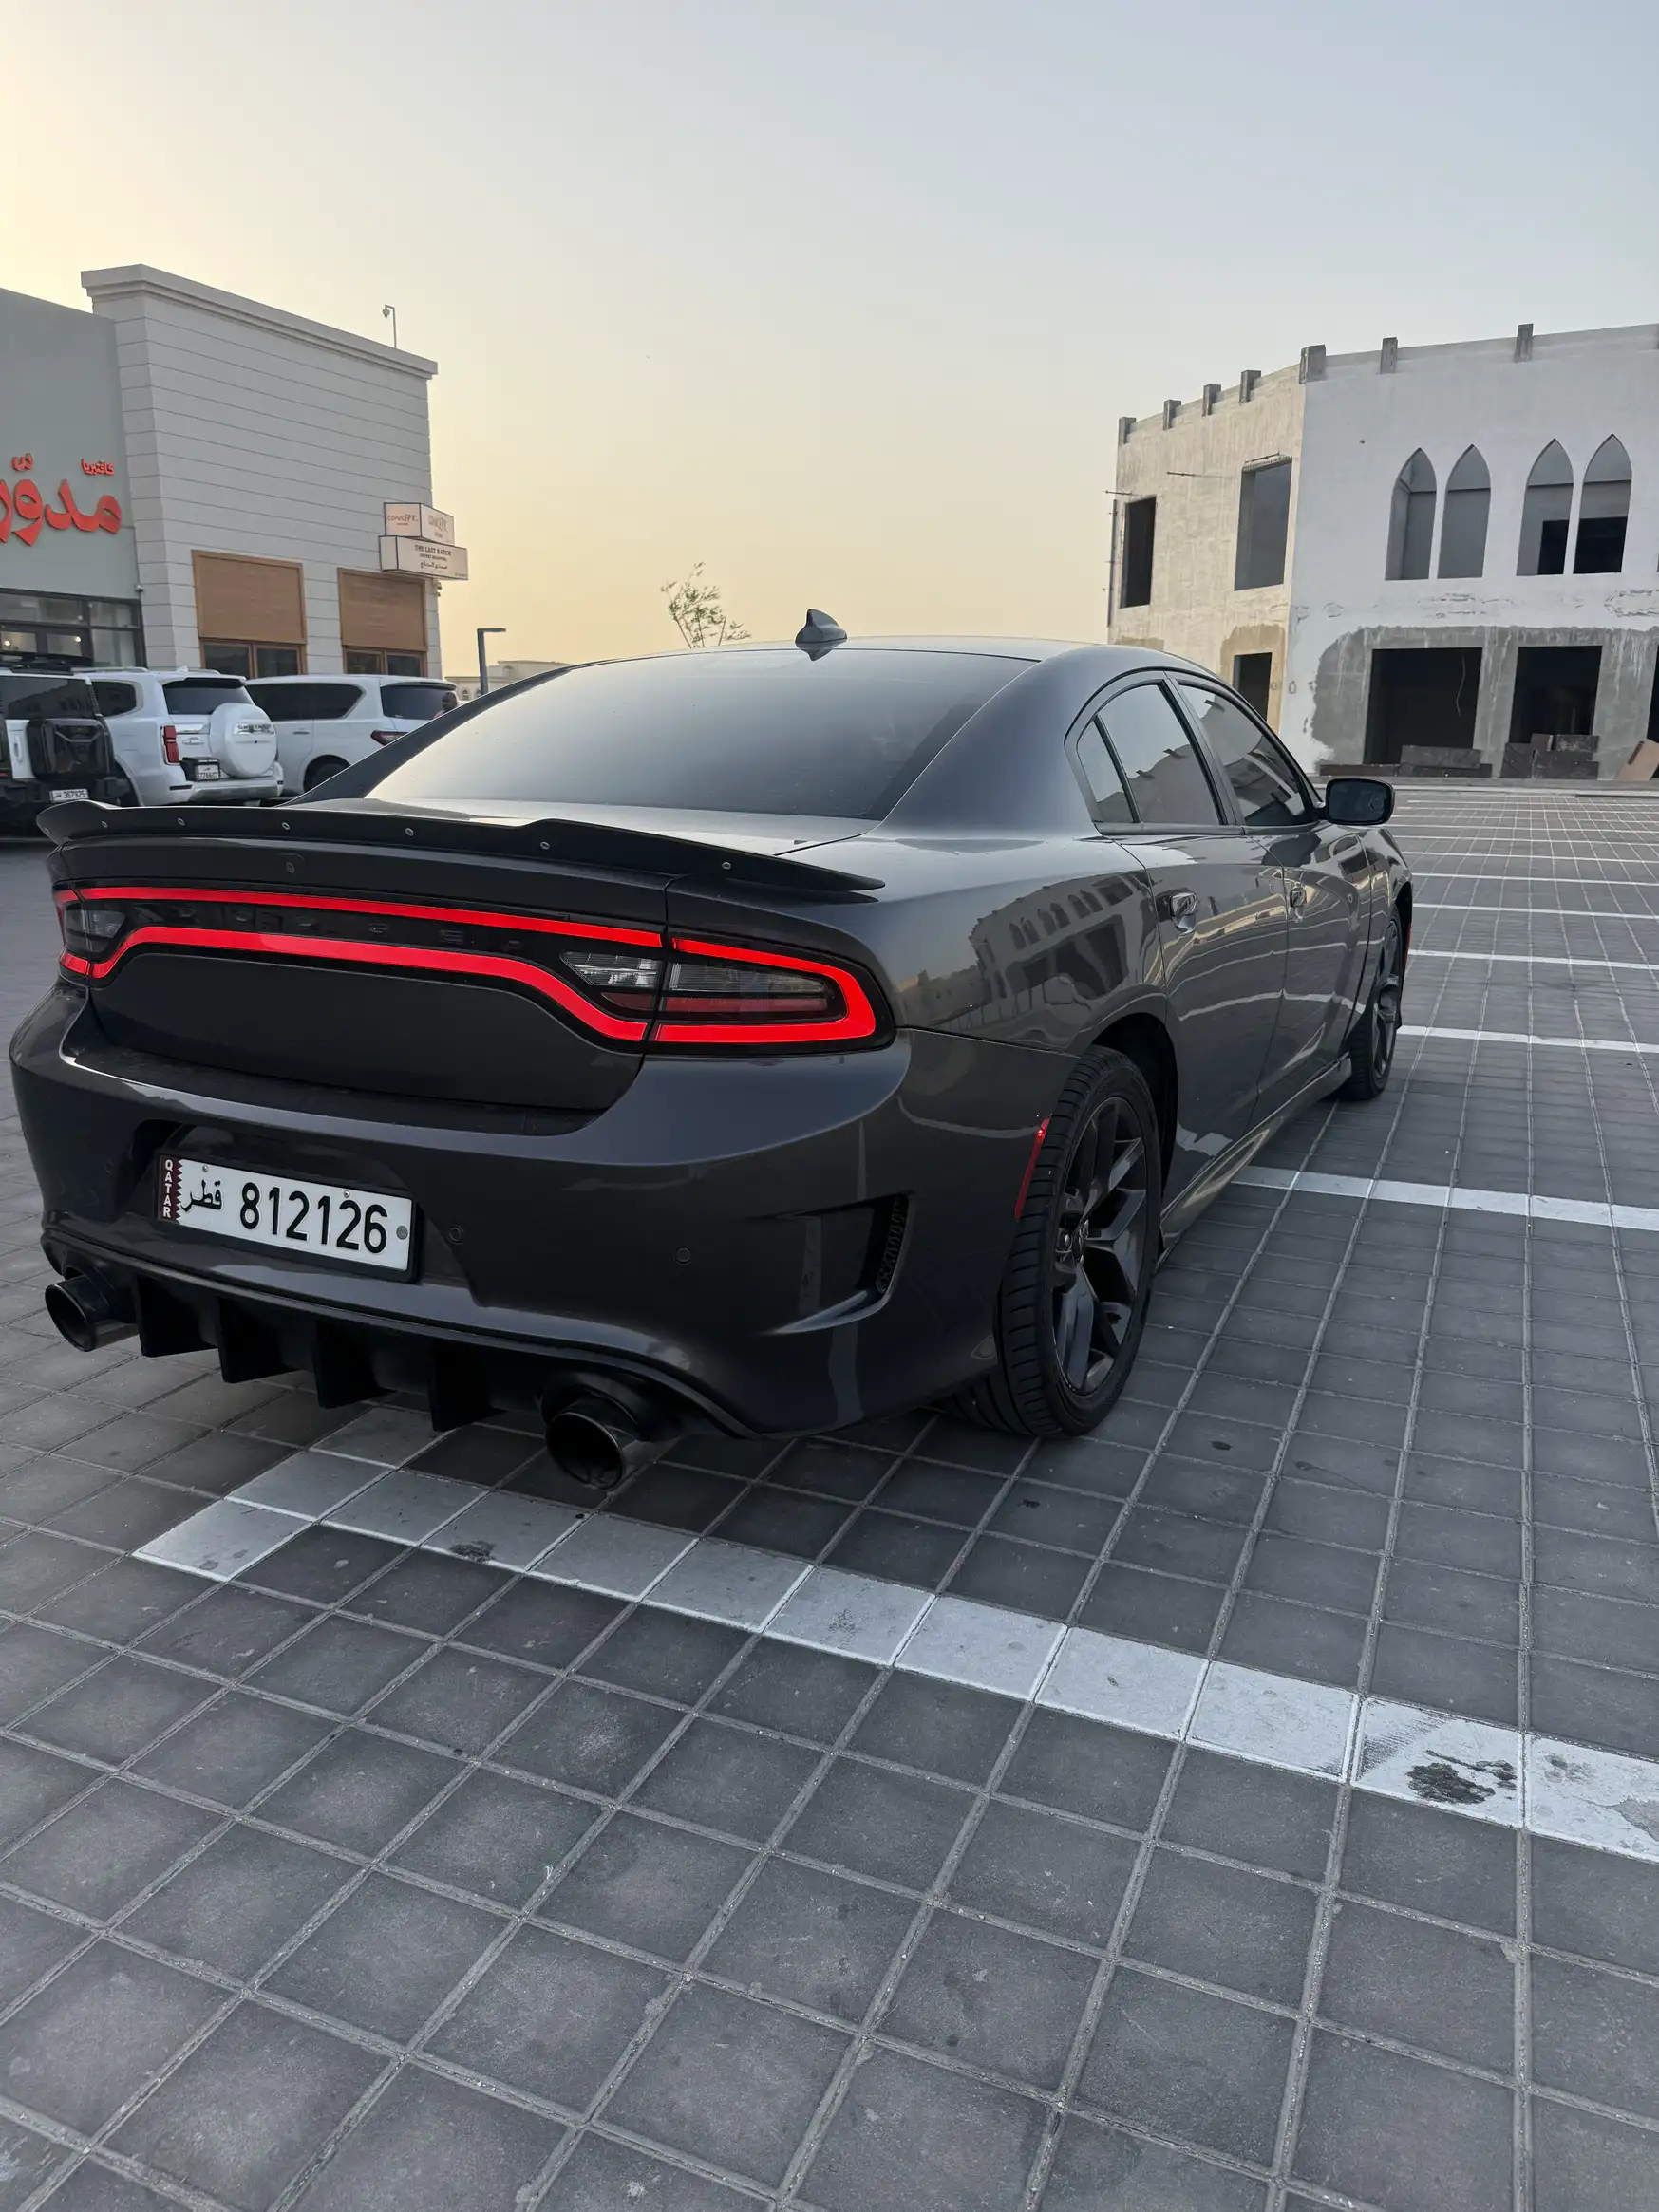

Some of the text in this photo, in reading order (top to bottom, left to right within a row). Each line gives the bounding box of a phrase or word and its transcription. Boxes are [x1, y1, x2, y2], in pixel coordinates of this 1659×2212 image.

[162, 1158, 174, 1218] QATAR
[180, 1179, 223, 1212] قطر
[239, 1181, 388, 1254] 812126
